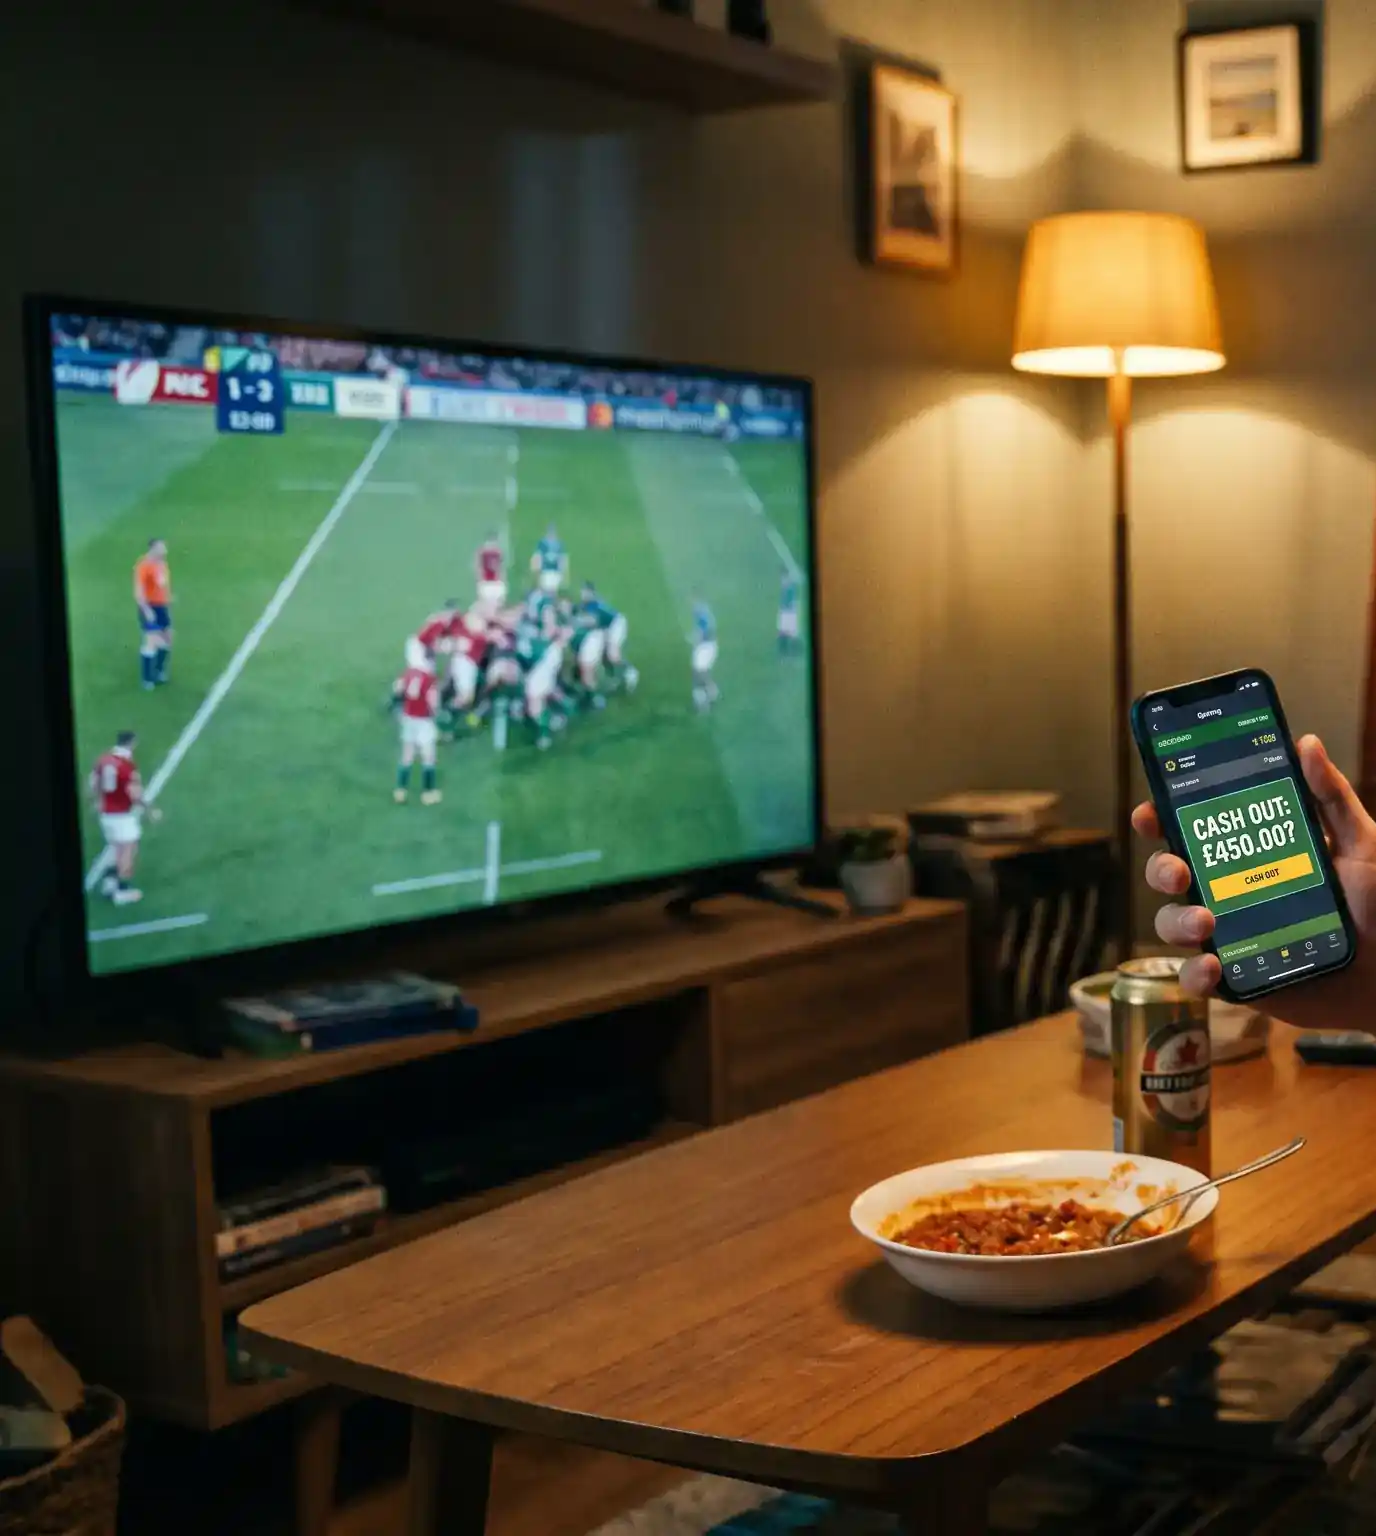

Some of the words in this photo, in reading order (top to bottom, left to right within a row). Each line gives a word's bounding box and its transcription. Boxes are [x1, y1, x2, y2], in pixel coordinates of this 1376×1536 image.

[1193, 807, 1246, 841] CASH
[1249, 796, 1292, 825] OUT:
[1202, 820, 1295, 868] £450.00?
[1244, 874, 1264, 885] CASH
[1265, 868, 1280, 879] OUT
